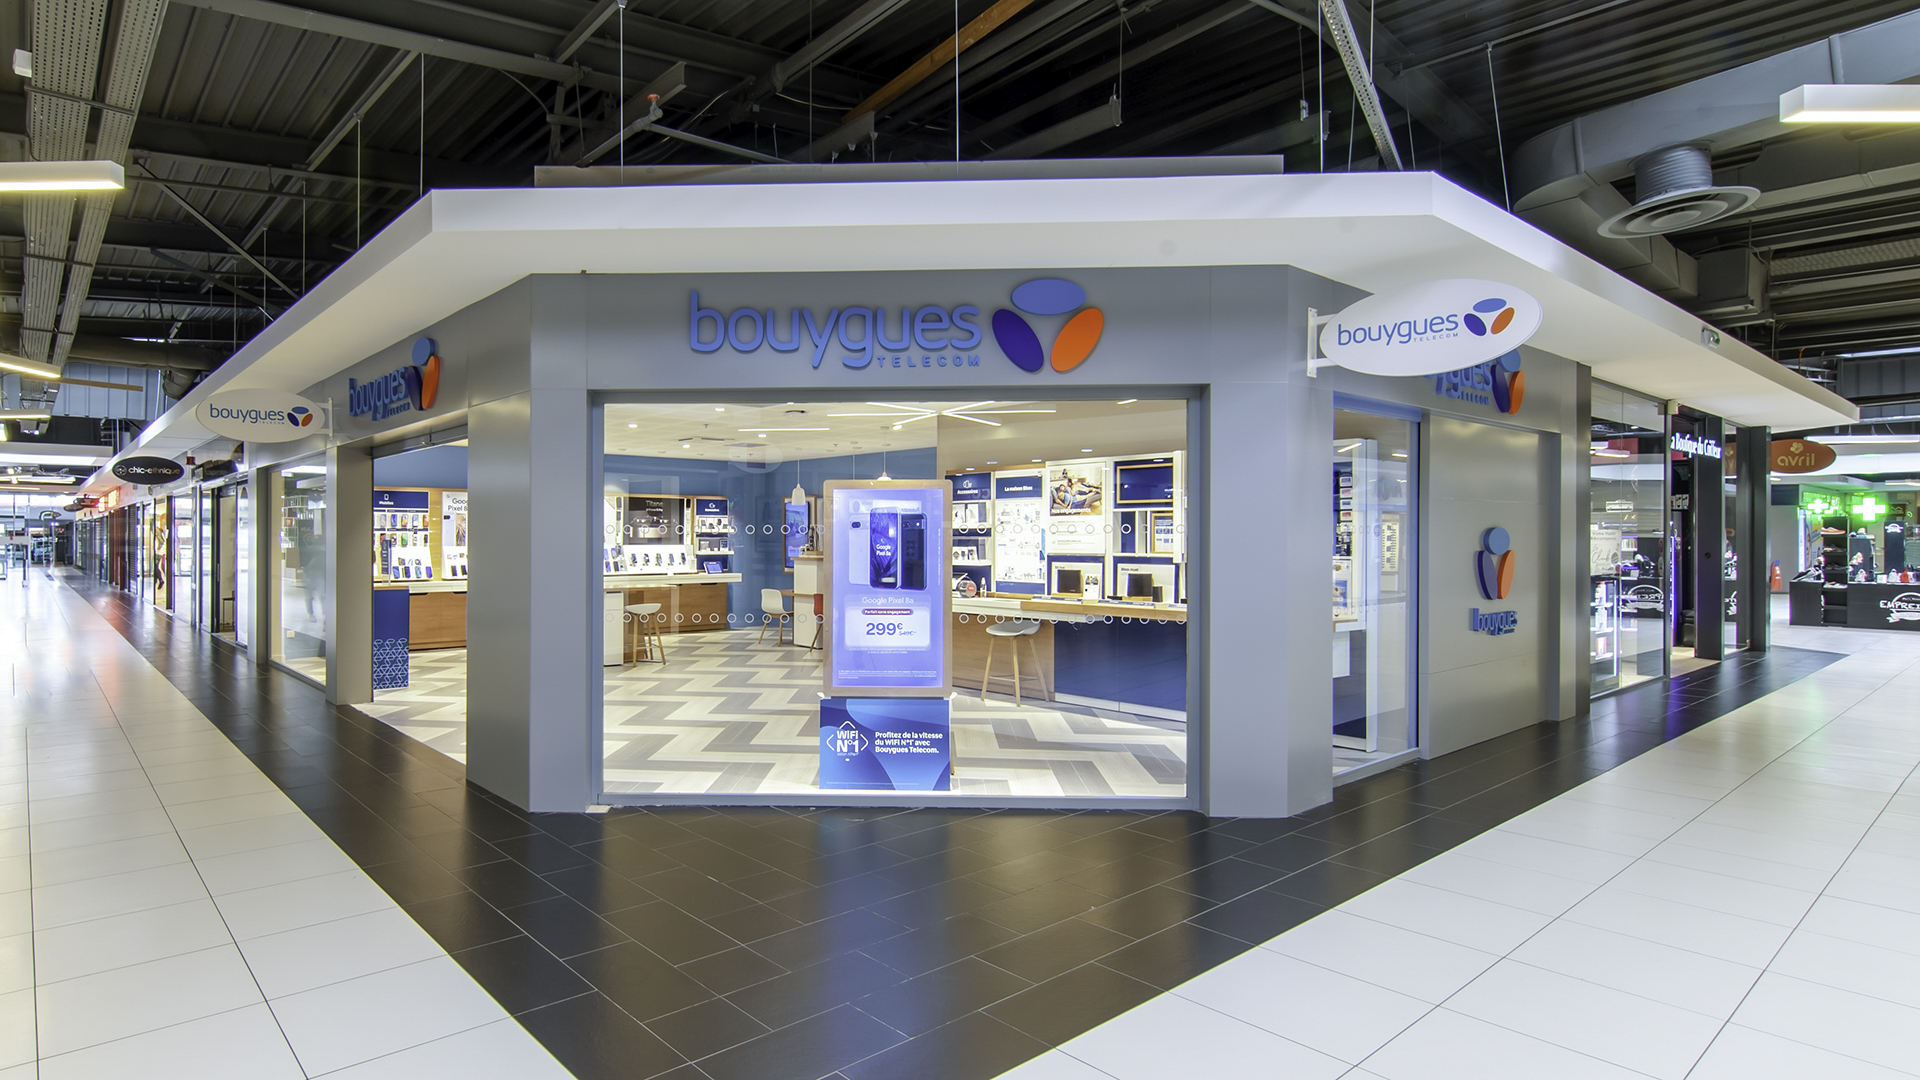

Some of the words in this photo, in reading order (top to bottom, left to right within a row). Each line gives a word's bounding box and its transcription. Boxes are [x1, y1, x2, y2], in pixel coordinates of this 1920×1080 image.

[690, 290, 982, 368] bouygues
[1338, 313, 1459, 346] bouygues
[1413, 332, 1459, 343] TELECOM
[877, 354, 981, 367] TELECOM
[348, 366, 409, 421] bouygues
[209, 403, 285, 424] bouygues
[1777, 453, 1815, 466] avril
[128, 466, 180, 475] chic-ethnique
[862, 597, 887, 605] Google
[837, 730, 859, 740] WiFi
[875, 731, 902, 739] Profitez
[837, 739, 859, 753] N°1
[875, 746, 908, 754] Bouygues
[909, 746, 940, 754] Telecom.
